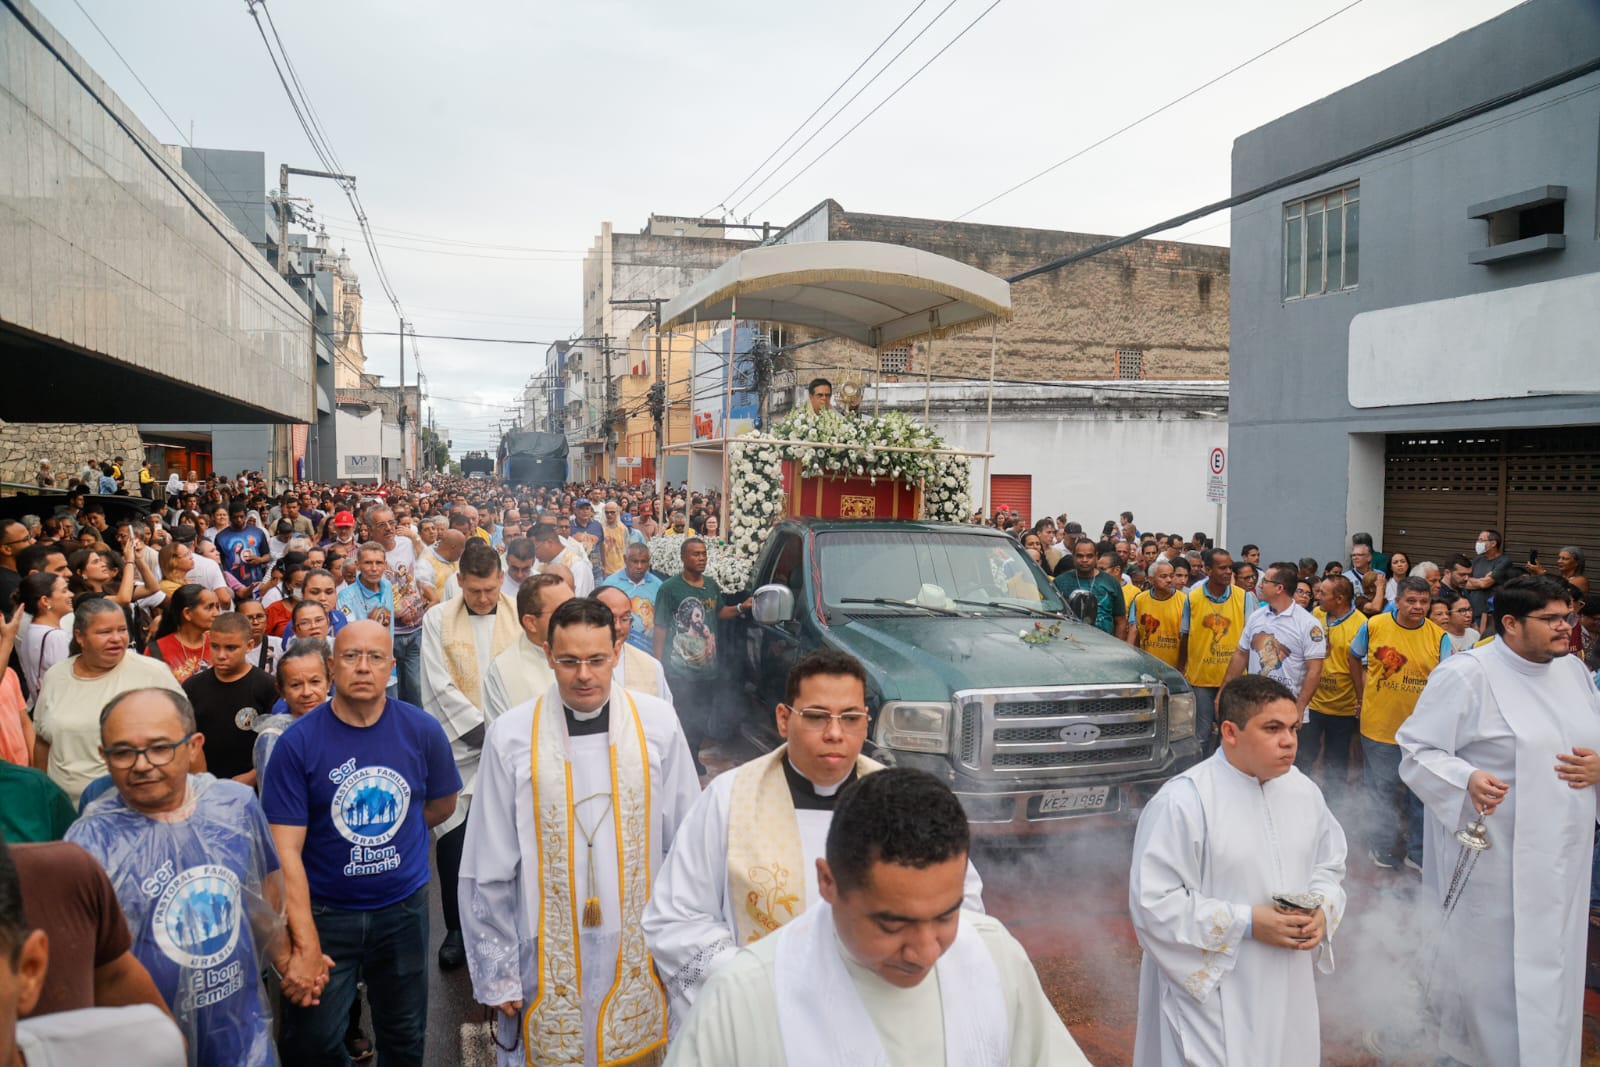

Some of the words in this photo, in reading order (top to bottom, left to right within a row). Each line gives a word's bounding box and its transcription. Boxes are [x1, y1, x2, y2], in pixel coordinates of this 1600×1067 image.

[1215, 454, 1220, 468] E
[329, 758, 356, 784] Ser
[334, 769, 371, 806] PASTORAL
[377, 768, 411, 798] FAMILIAR
[352, 833, 393, 845] BRASIL
[344, 855, 401, 876] demais!
[351, 846, 362, 862] É
[364, 846, 396, 863] bom
[141, 860, 175, 898] Ser
[154, 871, 194, 925] PASTORAL
[207, 960, 240, 988] bom
